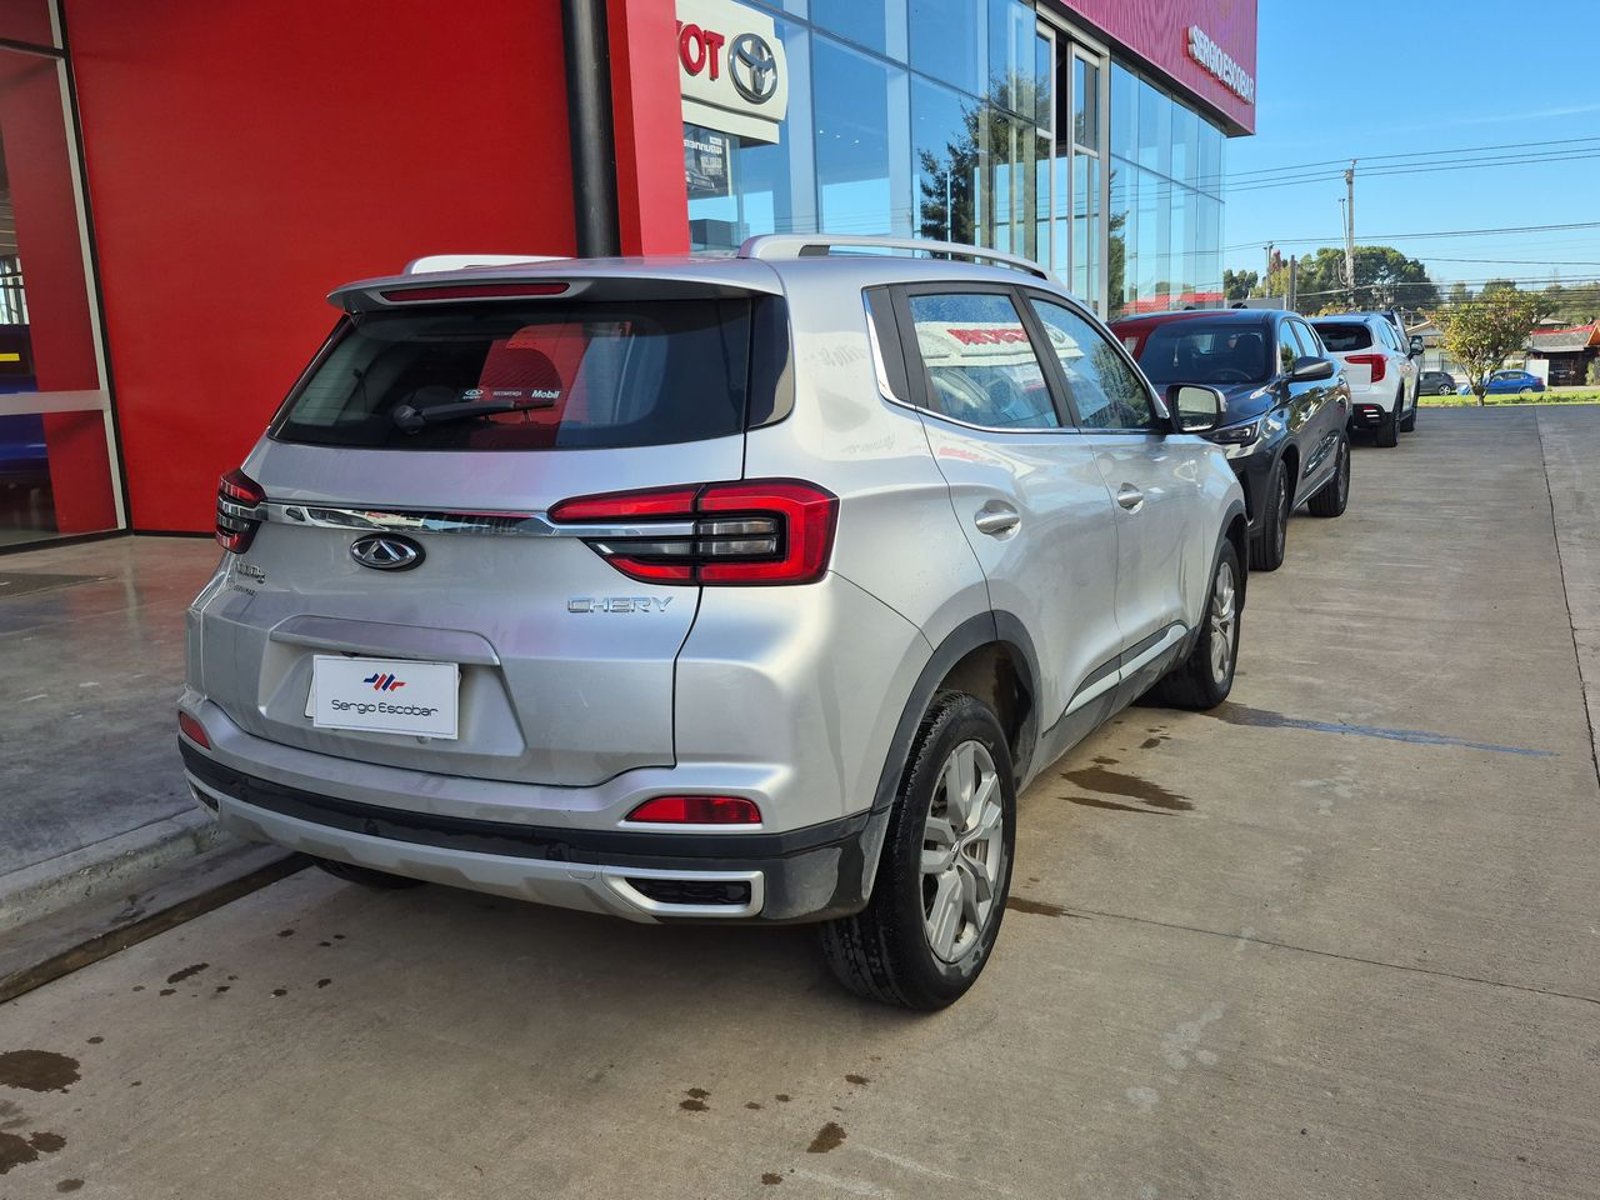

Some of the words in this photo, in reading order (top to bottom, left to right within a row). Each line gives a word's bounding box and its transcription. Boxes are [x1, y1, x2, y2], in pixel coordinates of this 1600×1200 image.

[532, 389, 561, 399] Mobil
[567, 596, 673, 613] CHERY
[378, 702, 438, 716] Escobar
